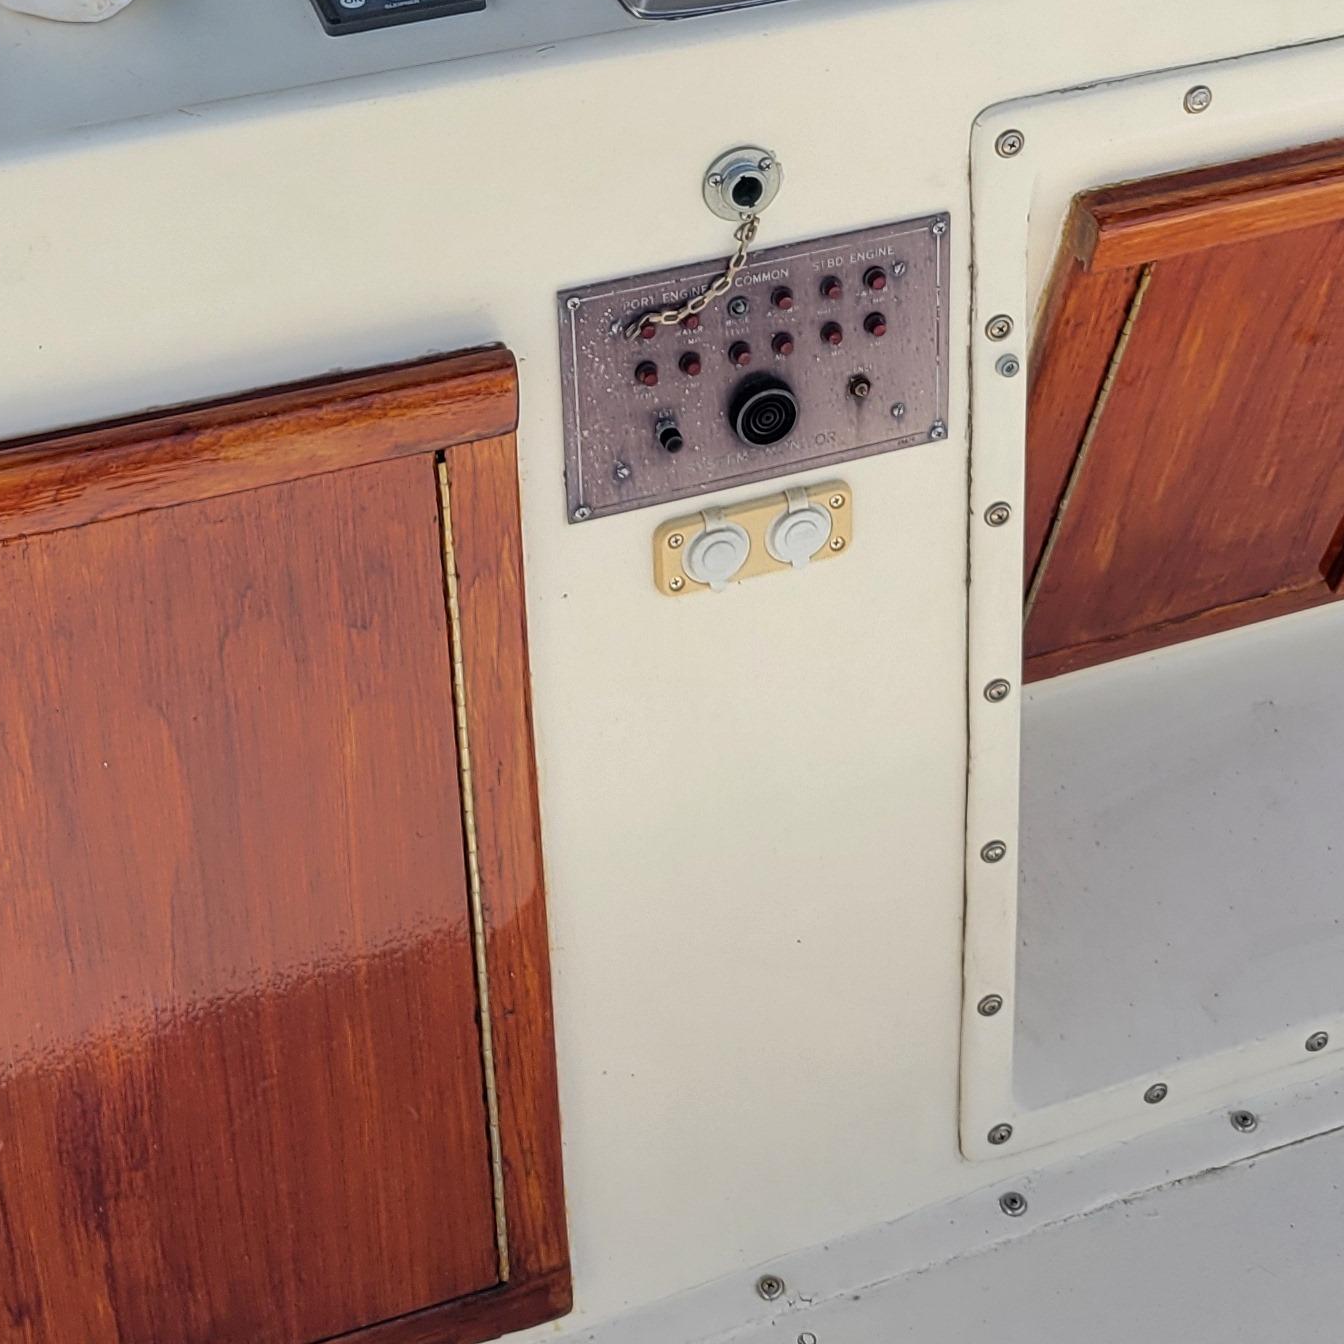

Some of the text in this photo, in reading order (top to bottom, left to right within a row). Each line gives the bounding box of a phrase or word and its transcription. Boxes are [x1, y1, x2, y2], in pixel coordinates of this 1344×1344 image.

[812, 246, 895, 271] STBD ENGINE
[734, 268, 790, 288] COMMON
